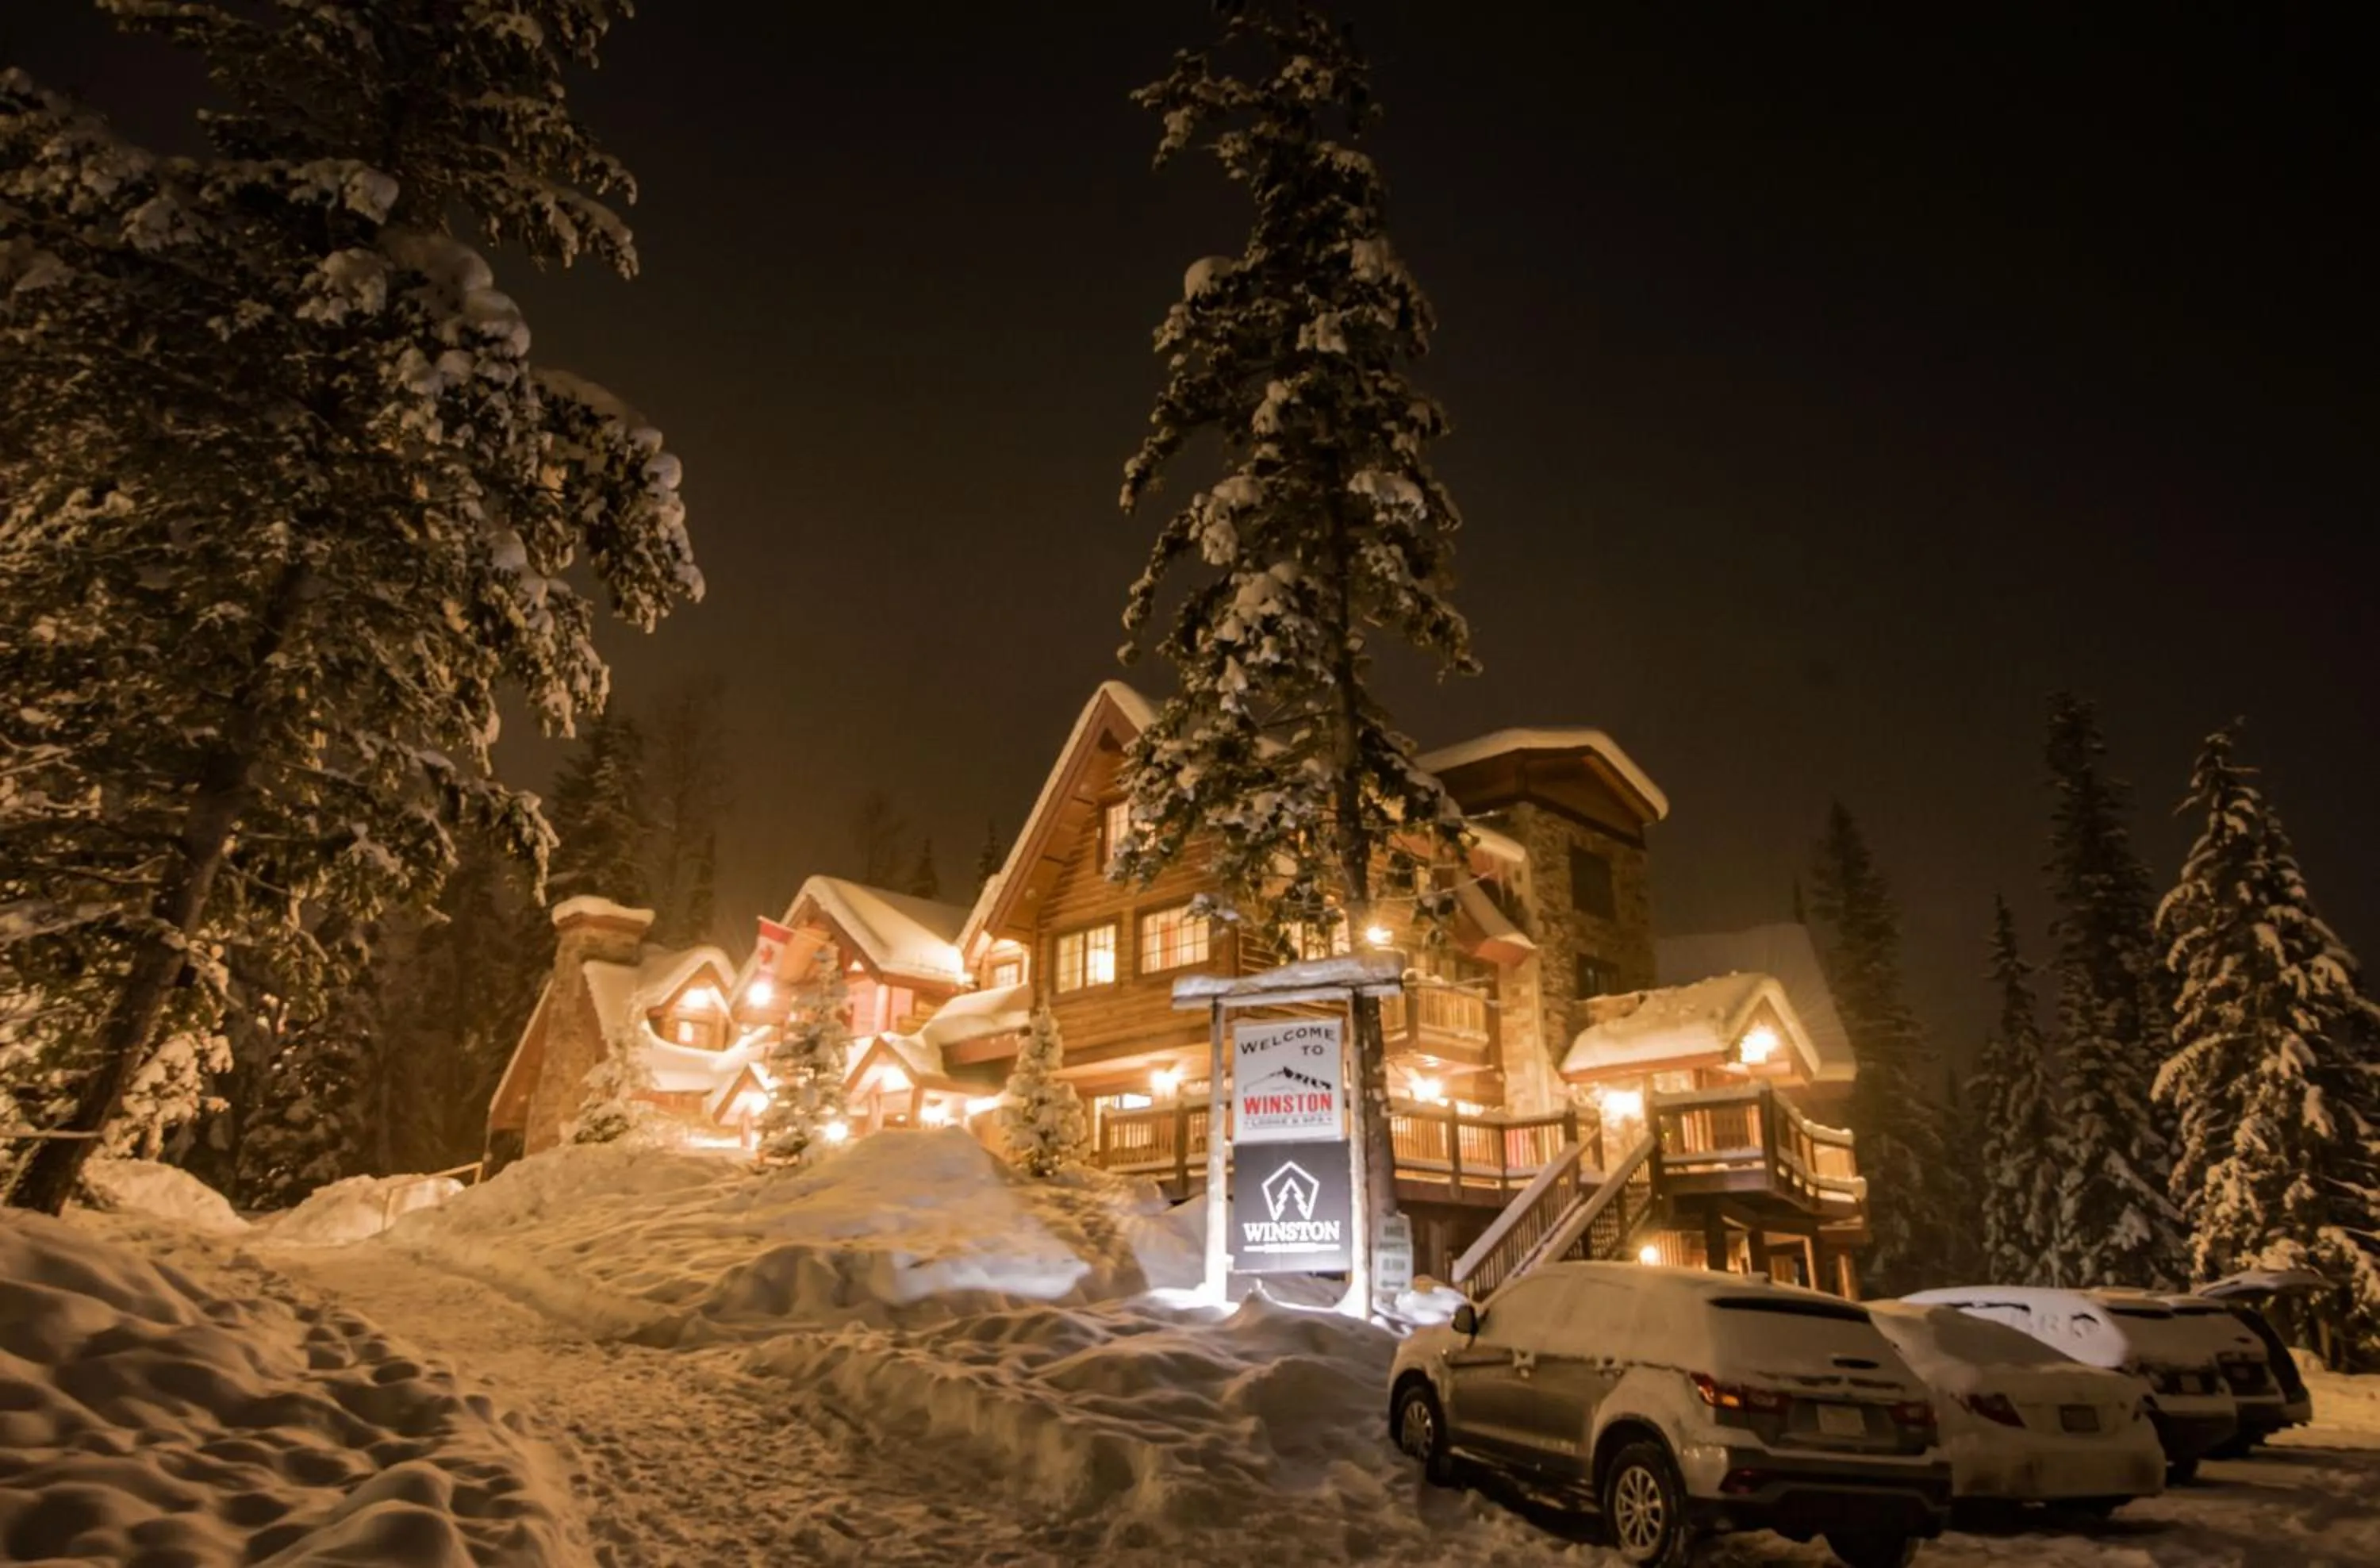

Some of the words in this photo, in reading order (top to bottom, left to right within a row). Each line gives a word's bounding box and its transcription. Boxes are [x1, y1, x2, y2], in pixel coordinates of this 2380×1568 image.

[1240, 1027, 1336, 1055] WELCOME
[1301, 1044, 1324, 1056] TO
[1243, 1093, 1333, 1115] WINSTON
[1243, 1220, 1340, 1242] WINSTON
